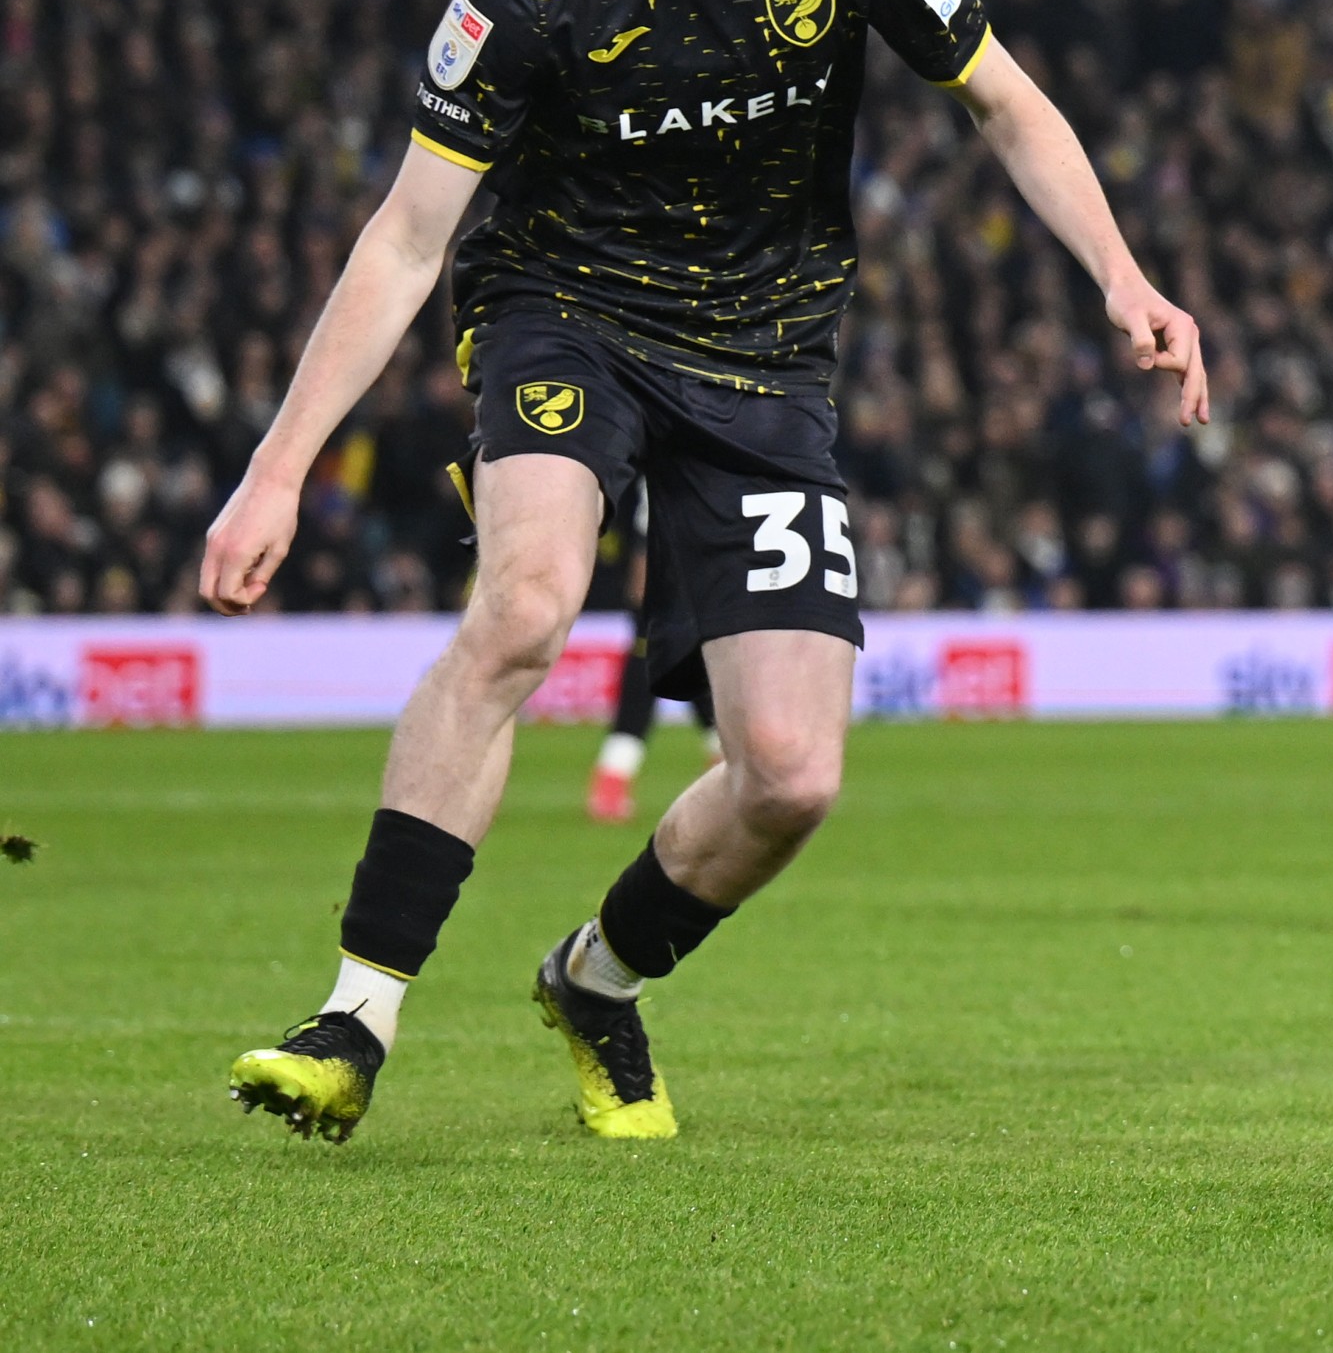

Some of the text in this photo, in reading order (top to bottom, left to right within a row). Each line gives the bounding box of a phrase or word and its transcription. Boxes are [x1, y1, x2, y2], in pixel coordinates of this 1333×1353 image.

[452, 2, 465, 22] sky
[463, 17, 483, 41] bet
[435, 62, 448, 81] EFL
[741, 491, 858, 600] 35
